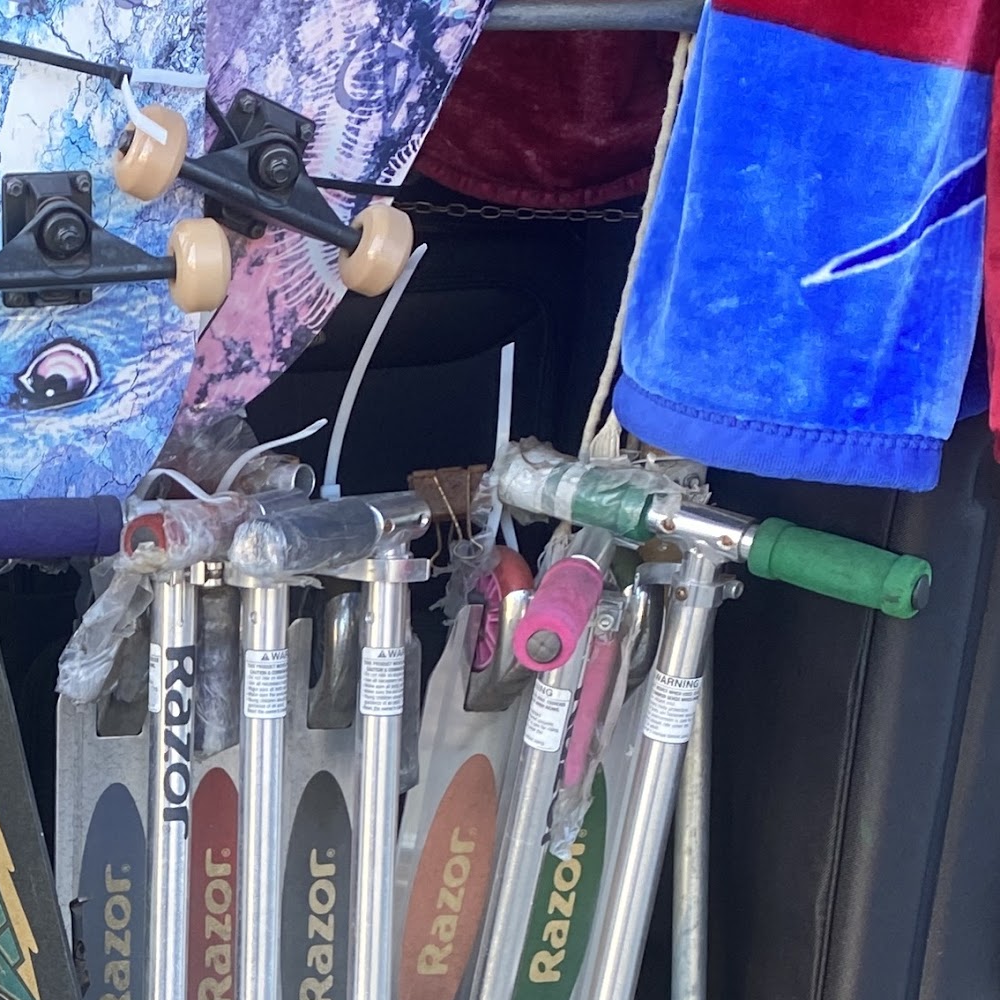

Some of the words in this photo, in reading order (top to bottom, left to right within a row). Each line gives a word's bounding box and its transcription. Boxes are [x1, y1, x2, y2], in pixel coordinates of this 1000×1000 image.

[162, 645, 196, 840] Razor
[655, 673, 700, 689] WARNING
[417, 826, 477, 975] Razor
